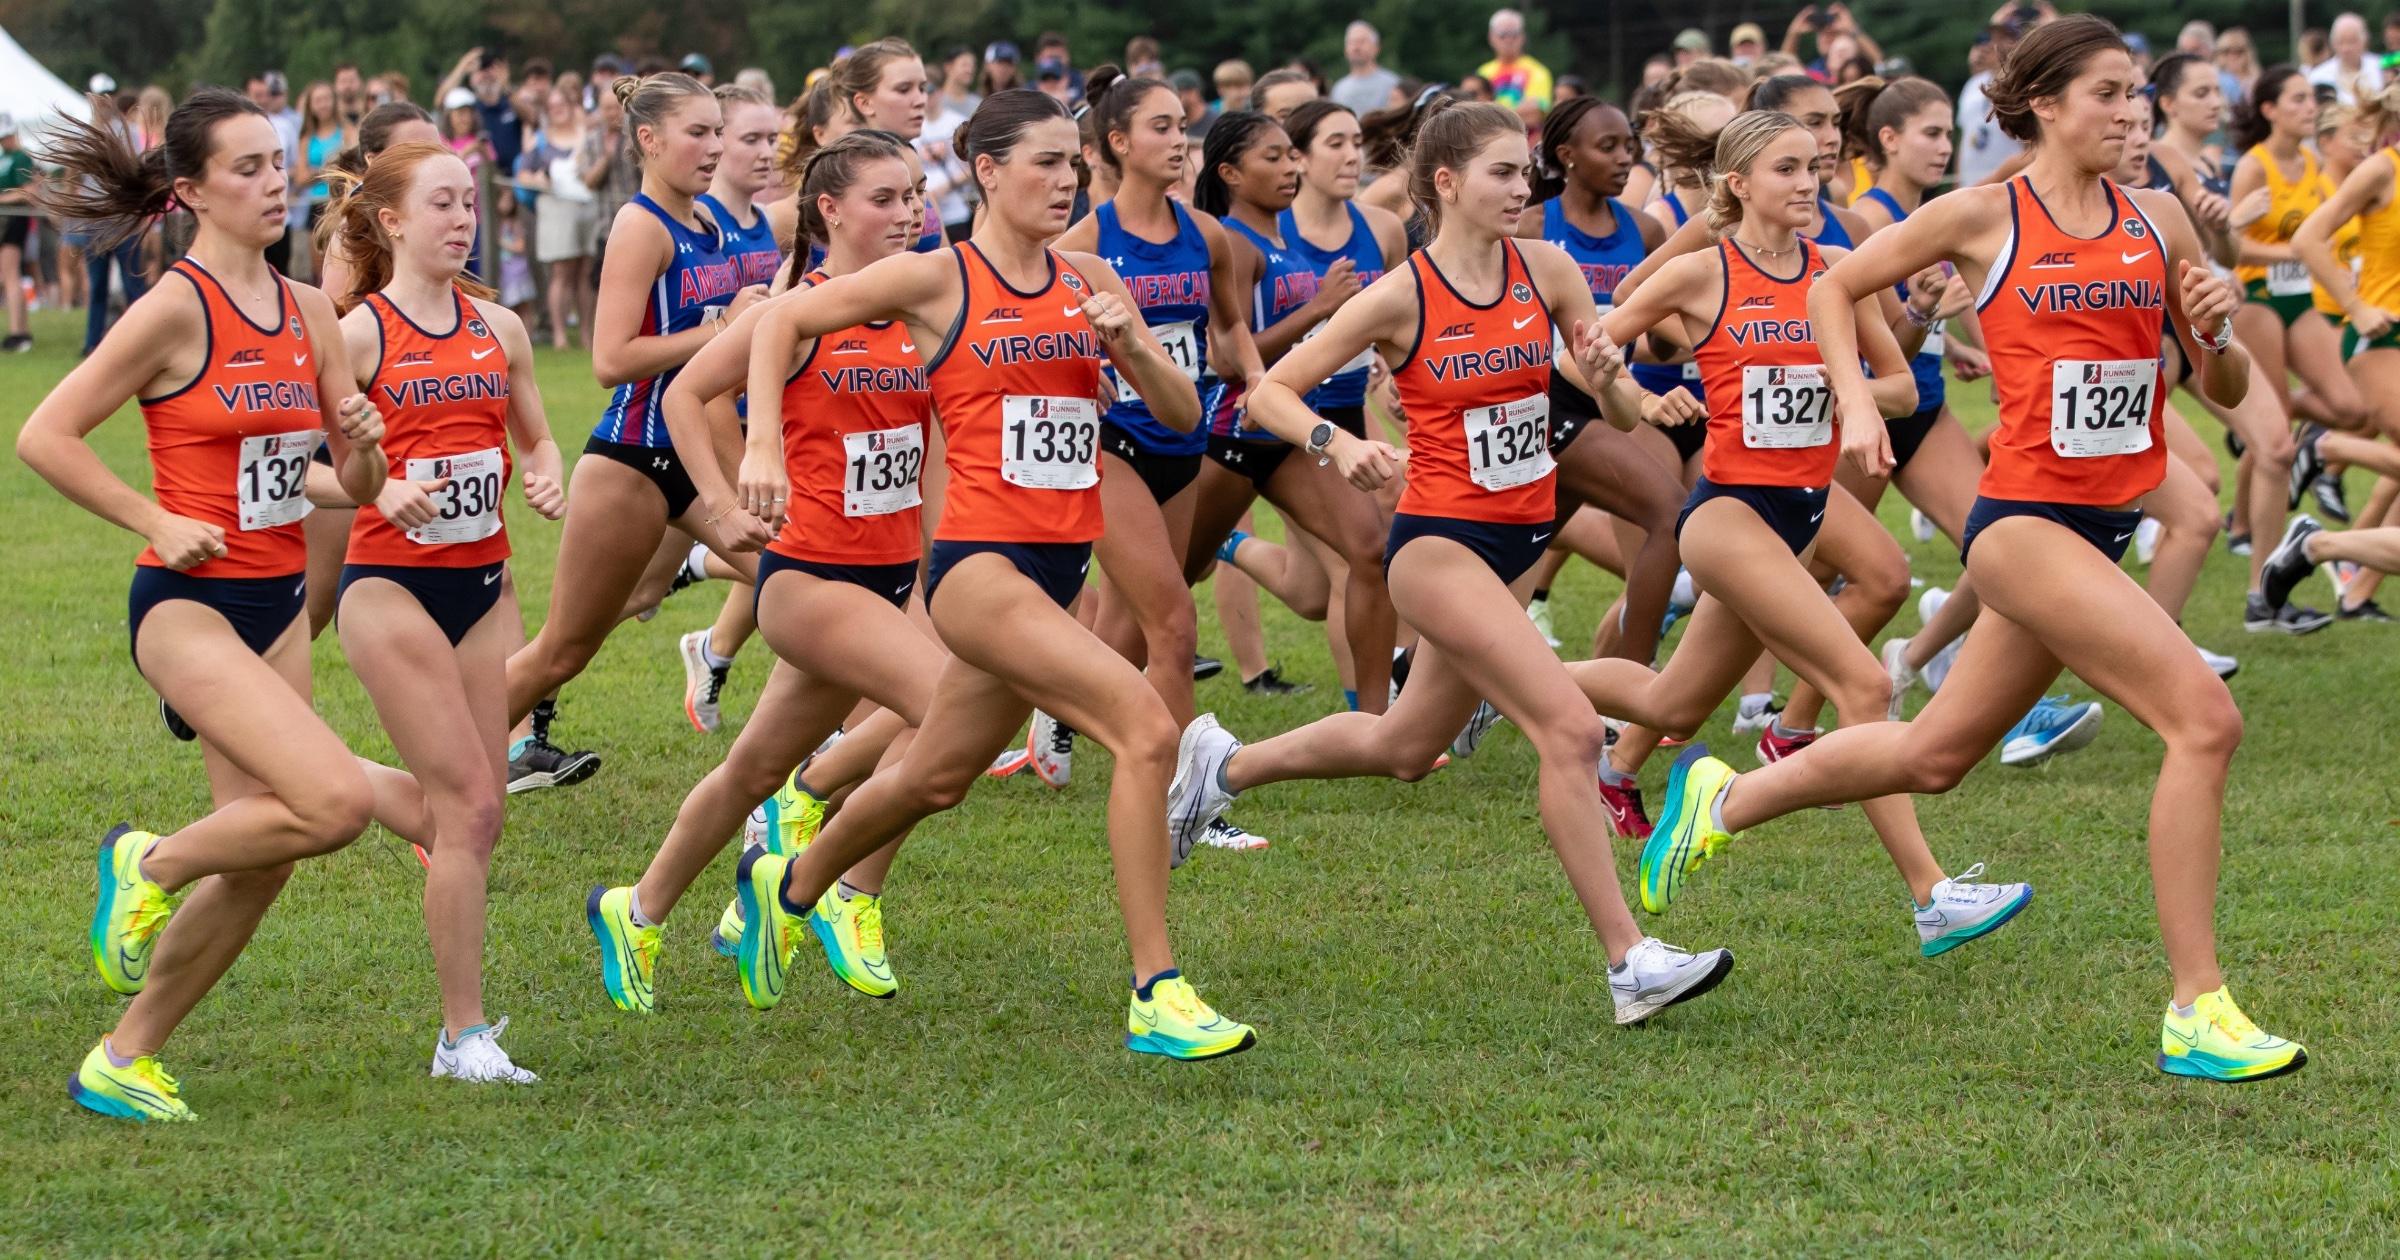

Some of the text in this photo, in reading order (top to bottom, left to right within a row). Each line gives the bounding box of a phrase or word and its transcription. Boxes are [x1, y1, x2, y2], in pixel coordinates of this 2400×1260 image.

[2034, 252, 2076, 265] ACC
[1123, 271, 1211, 308] MERICAN
[1741, 295, 1775, 307] ACC
[2016, 279, 2163, 315] VIRGINIA
[985, 307, 1023, 320] ACC
[1439, 322, 1475, 337] ACC
[1725, 319, 1818, 347] VIRGI
[228, 348, 264, 363] ACC
[398, 351, 432, 364] ACC
[836, 340, 868, 352] ACC
[1424, 338, 1552, 383] VIRGINIA
[2103, 369, 2136, 378] RUNNING
[819, 366, 929, 394] VIRGINI
[1050, 405, 1081, 414] RUNNING
[1748, 387, 1831, 424] 1327
[2060, 384, 2148, 430] 1324
[1009, 419, 1095, 464] 1333
[1473, 414, 1546, 468] 1325
[851, 446, 921, 491] 1332
[440, 472, 499, 520] 330
